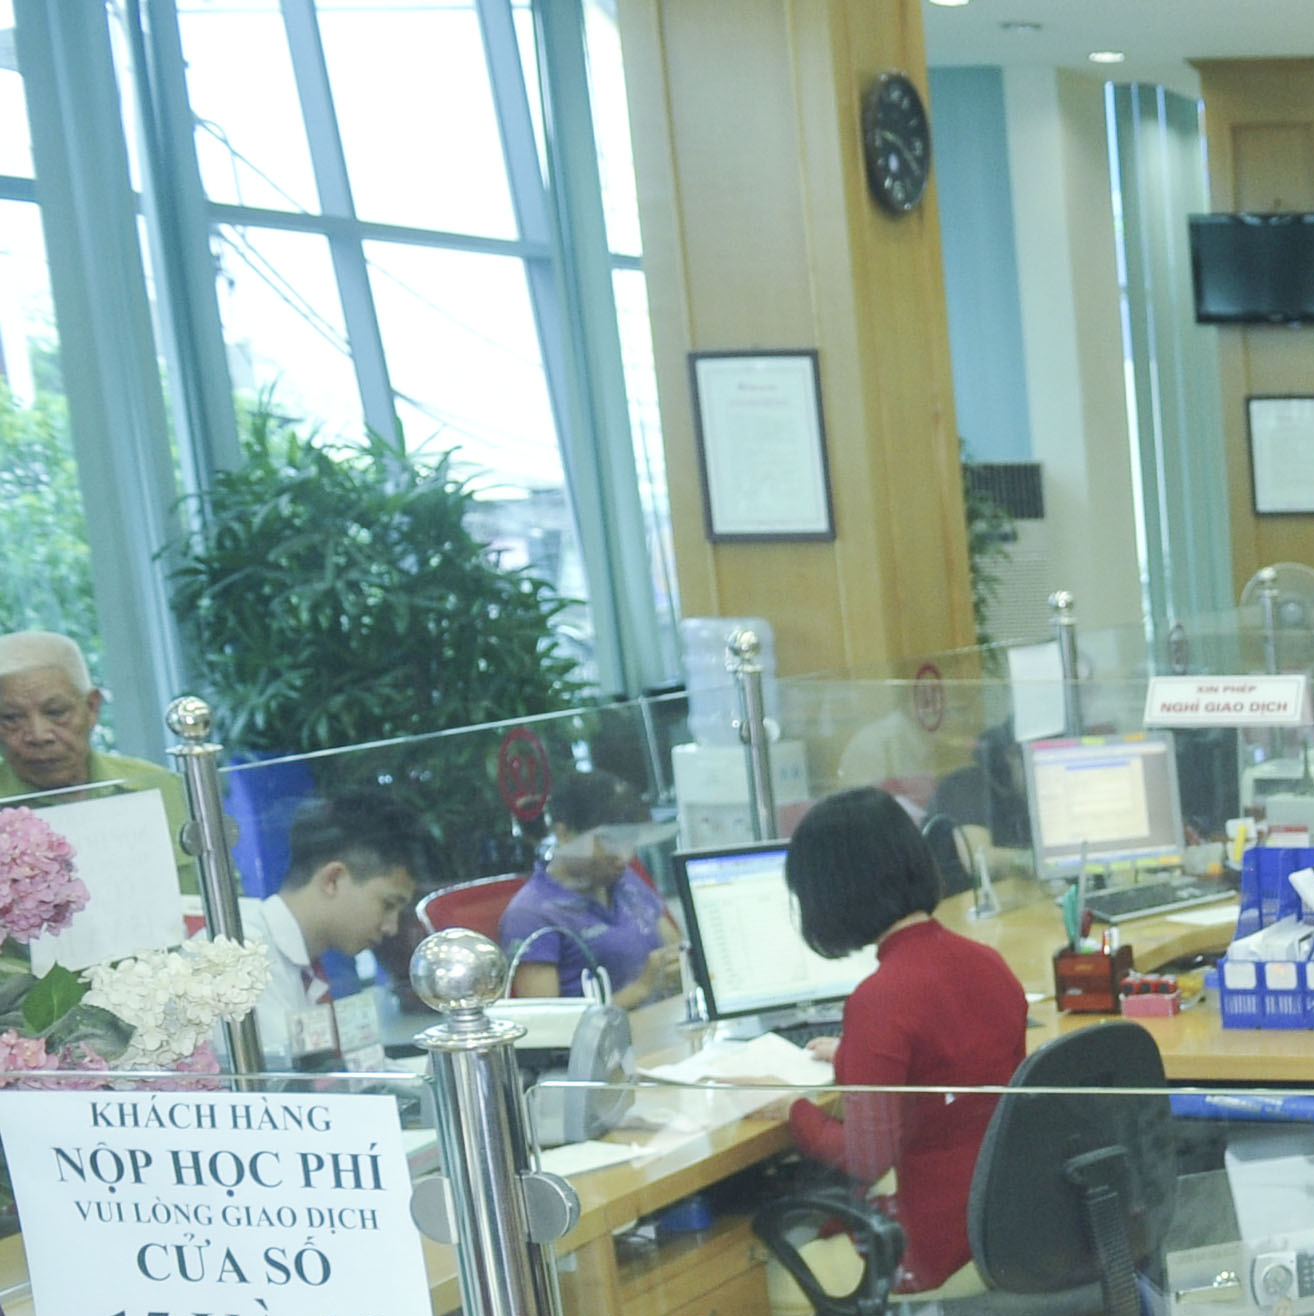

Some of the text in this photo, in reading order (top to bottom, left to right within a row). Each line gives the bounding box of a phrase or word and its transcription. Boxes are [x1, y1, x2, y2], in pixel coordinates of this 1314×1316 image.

[1204, 701, 1244, 712] GIAO
[1250, 701, 1288, 715] DỊCH
[90, 1095, 332, 1132] KHÁCH HÀNG
[52, 1142, 387, 1198] NỘP HỌC PHÍ
[74, 1196, 380, 1234] VUI LÒNG GIAO DỊCH
[137, 1231, 332, 1286] CỬA SỐ
